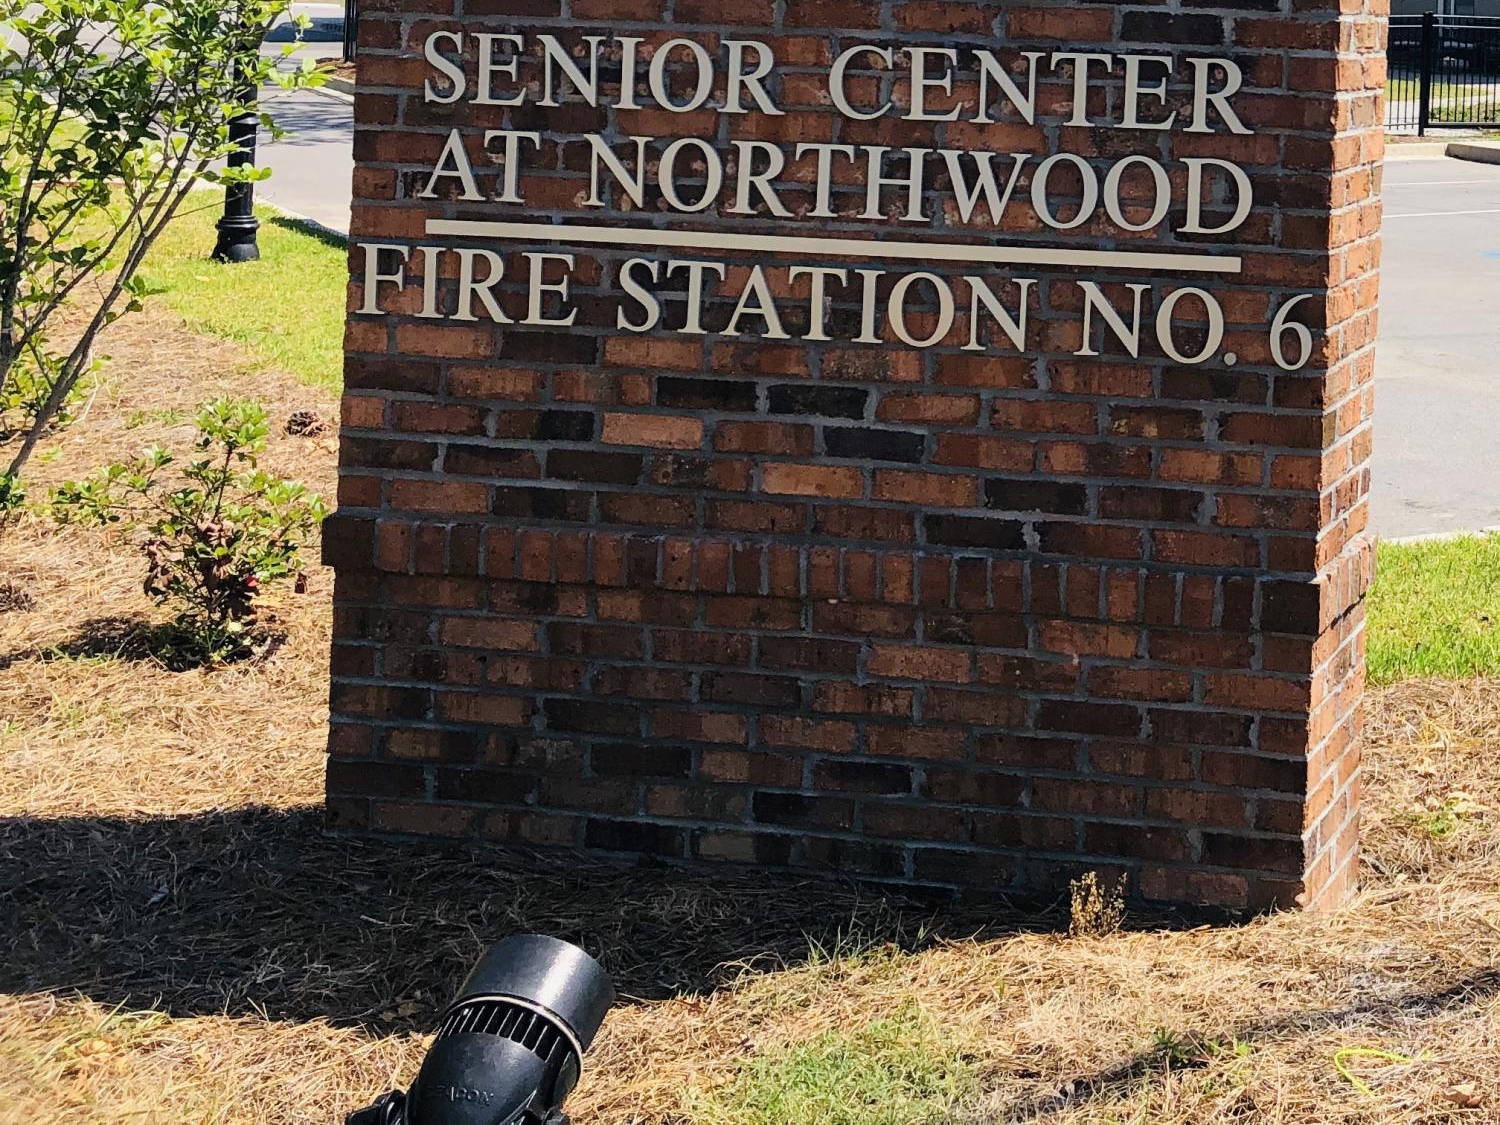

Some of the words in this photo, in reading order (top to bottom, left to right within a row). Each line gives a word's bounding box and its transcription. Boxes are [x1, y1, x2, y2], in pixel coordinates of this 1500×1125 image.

[424, 30, 785, 116] SENIOR
[829, 44, 1254, 135] CENTER
[417, 128, 540, 204] AT
[580, 133, 1253, 234] NORTHWOOD
[355, 242, 578, 327] FIRE
[616, 257, 1037, 354] STATION
[1073, 280, 1237, 366] NO.
[1269, 293, 1314, 371] 6
